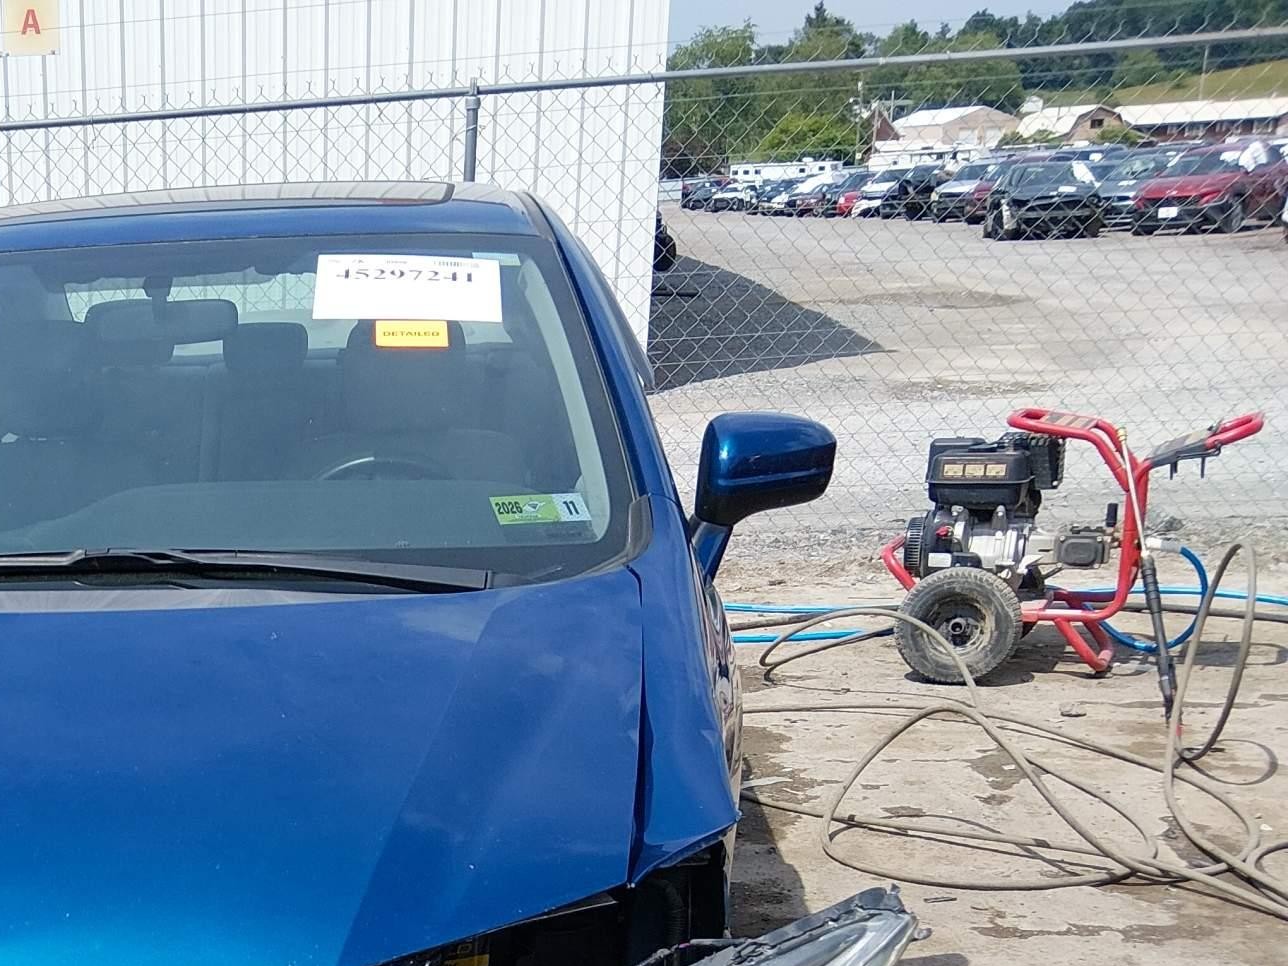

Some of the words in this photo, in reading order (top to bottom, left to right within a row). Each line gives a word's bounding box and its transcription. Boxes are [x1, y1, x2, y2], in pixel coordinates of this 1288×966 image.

[21, 8, 41, 36] A
[336, 268, 472, 282] 45297241
[494, 500, 524, 515] 2026
[562, 499, 580, 516] 11
